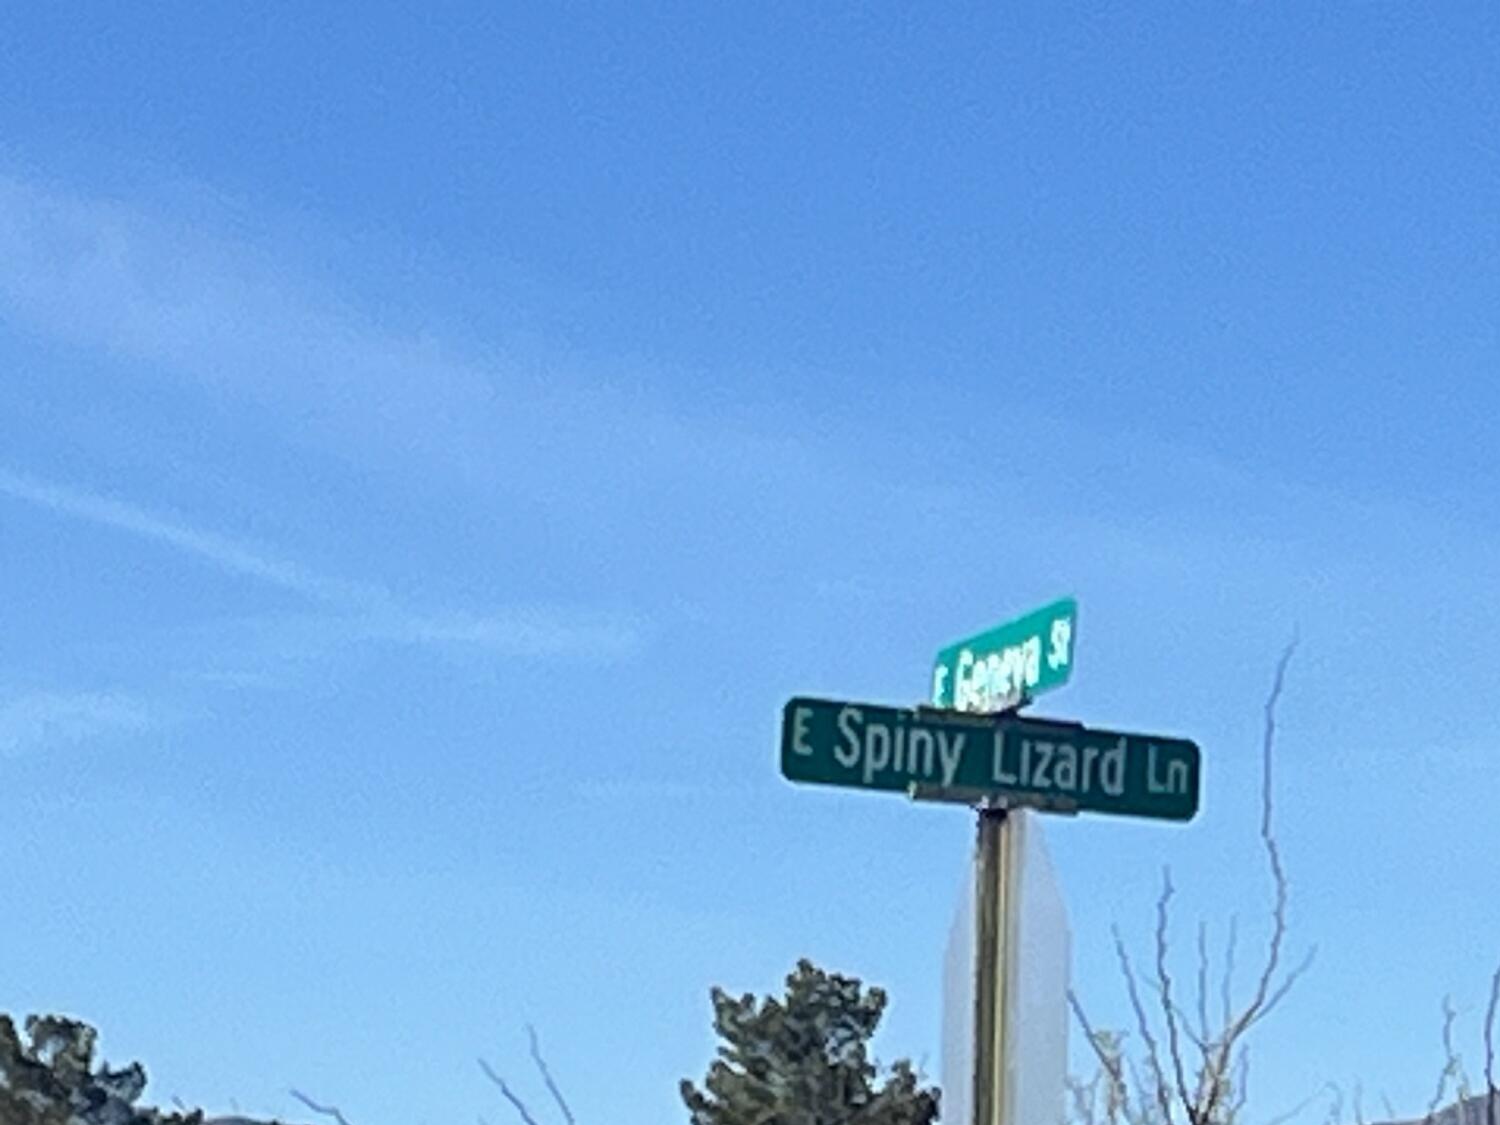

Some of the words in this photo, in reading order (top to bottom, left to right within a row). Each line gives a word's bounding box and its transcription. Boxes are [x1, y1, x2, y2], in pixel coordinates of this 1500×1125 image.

[933, 664, 949, 709] E
[953, 635, 1040, 712] Geneva
[1047, 617, 1071, 671] St
[793, 707, 814, 756] E
[834, 705, 966, 787] Spiny
[992, 730, 1128, 797] Lizard
[1147, 746, 1189, 794] Ln
